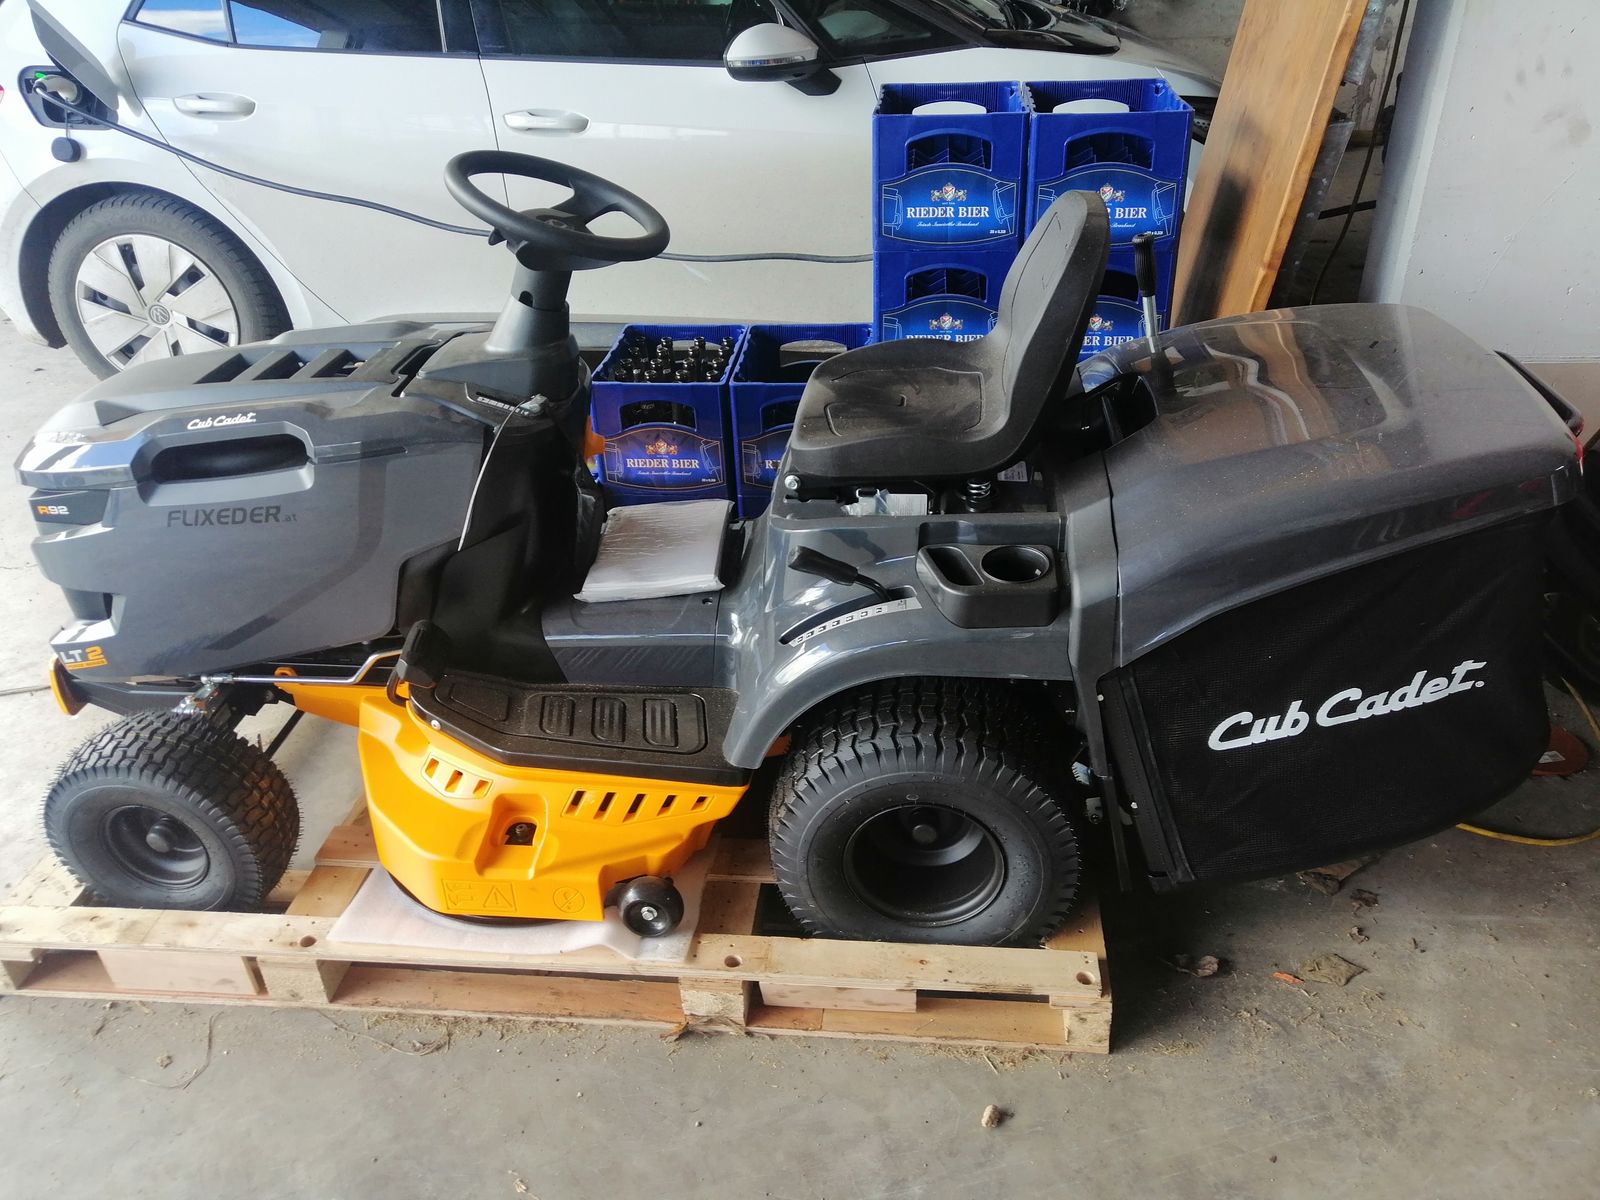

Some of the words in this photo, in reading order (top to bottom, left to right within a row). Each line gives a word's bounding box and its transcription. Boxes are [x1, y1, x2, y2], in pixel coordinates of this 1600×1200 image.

[906, 206, 955, 218] RIEDER
[957, 206, 990, 218] BIER
[1114, 207, 1147, 219] BIER
[187, 417, 213, 430] Cub
[626, 458, 669, 468] RIEDER
[671, 459, 700, 469] BIER
[37, 505, 70, 515] R92
[60, 649, 83, 664] LT
[84, 645, 105, 661] 2
[1208, 700, 1310, 750] Cub
